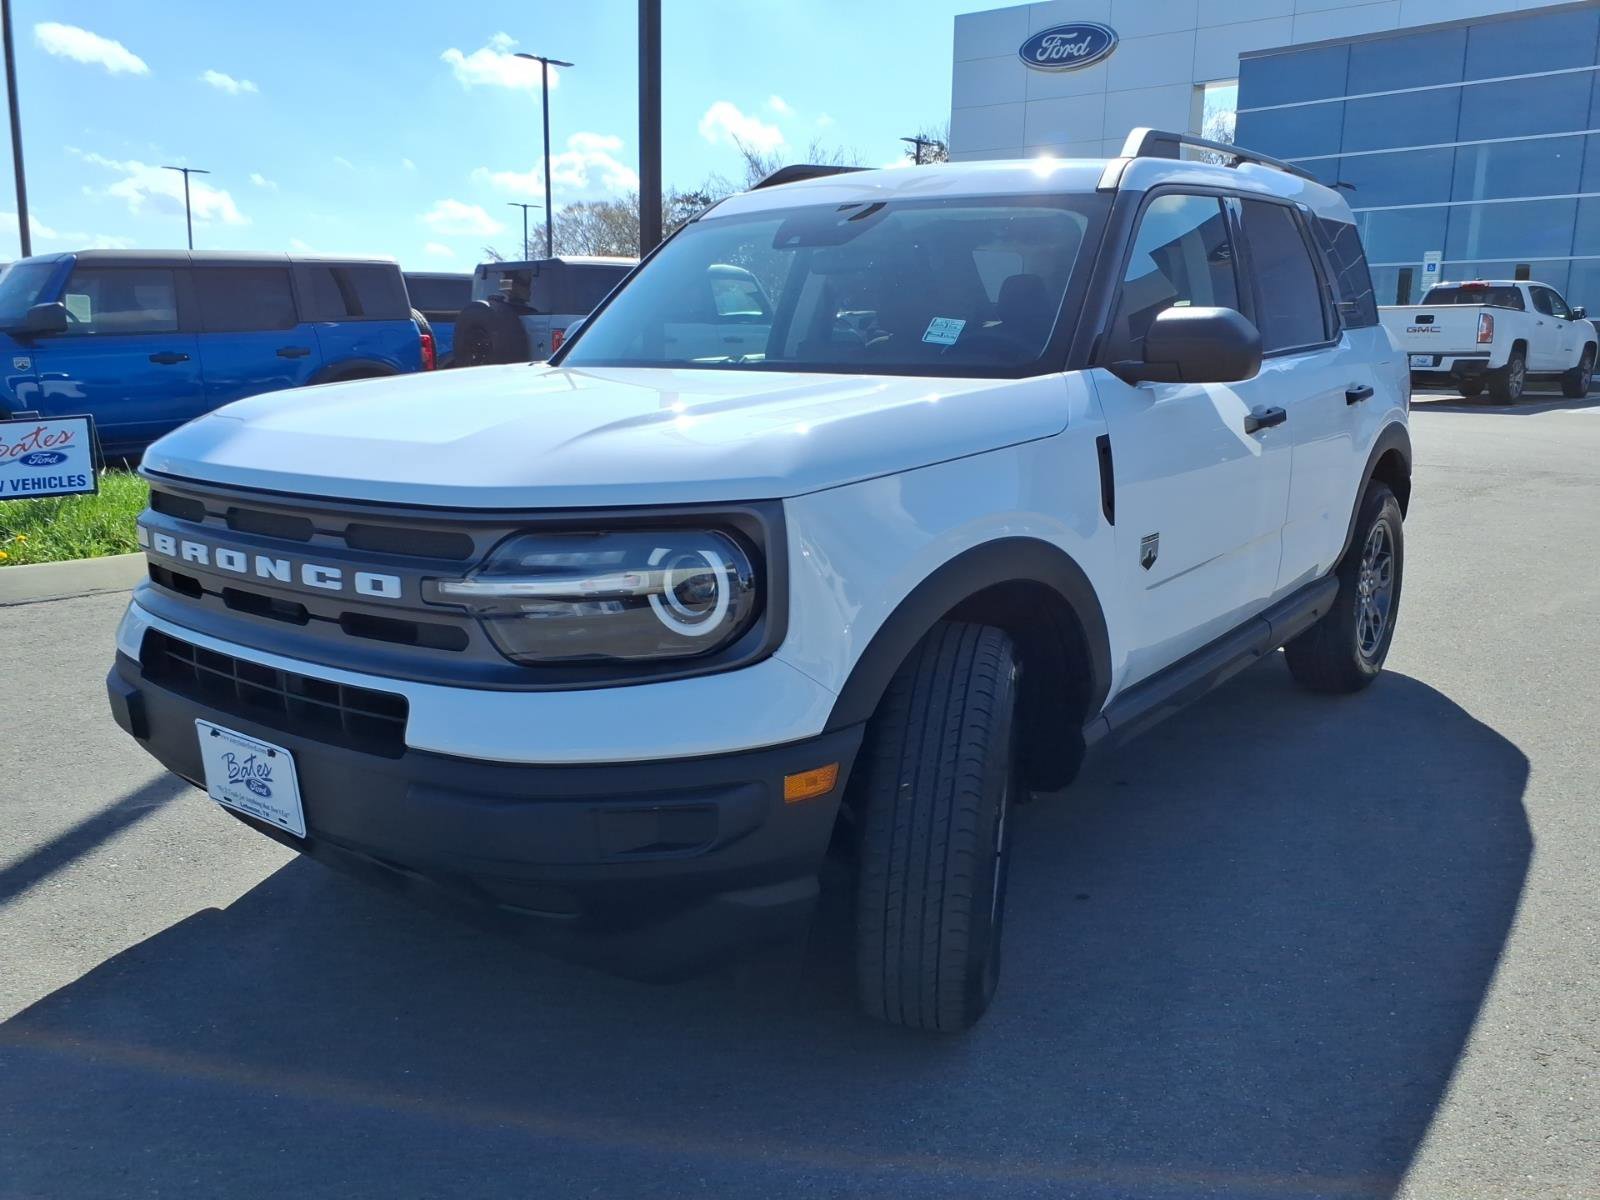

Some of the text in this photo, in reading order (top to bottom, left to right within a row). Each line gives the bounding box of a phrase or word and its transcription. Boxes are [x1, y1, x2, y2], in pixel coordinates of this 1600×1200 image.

[1036, 32, 1091, 61] Ford
[28, 453, 58, 465] Ford
[10, 474, 87, 492] VEHICLES
[153, 532, 402, 599] BRONCO
[221, 752, 272, 779] Bates
[249, 779, 268, 795] Ford
